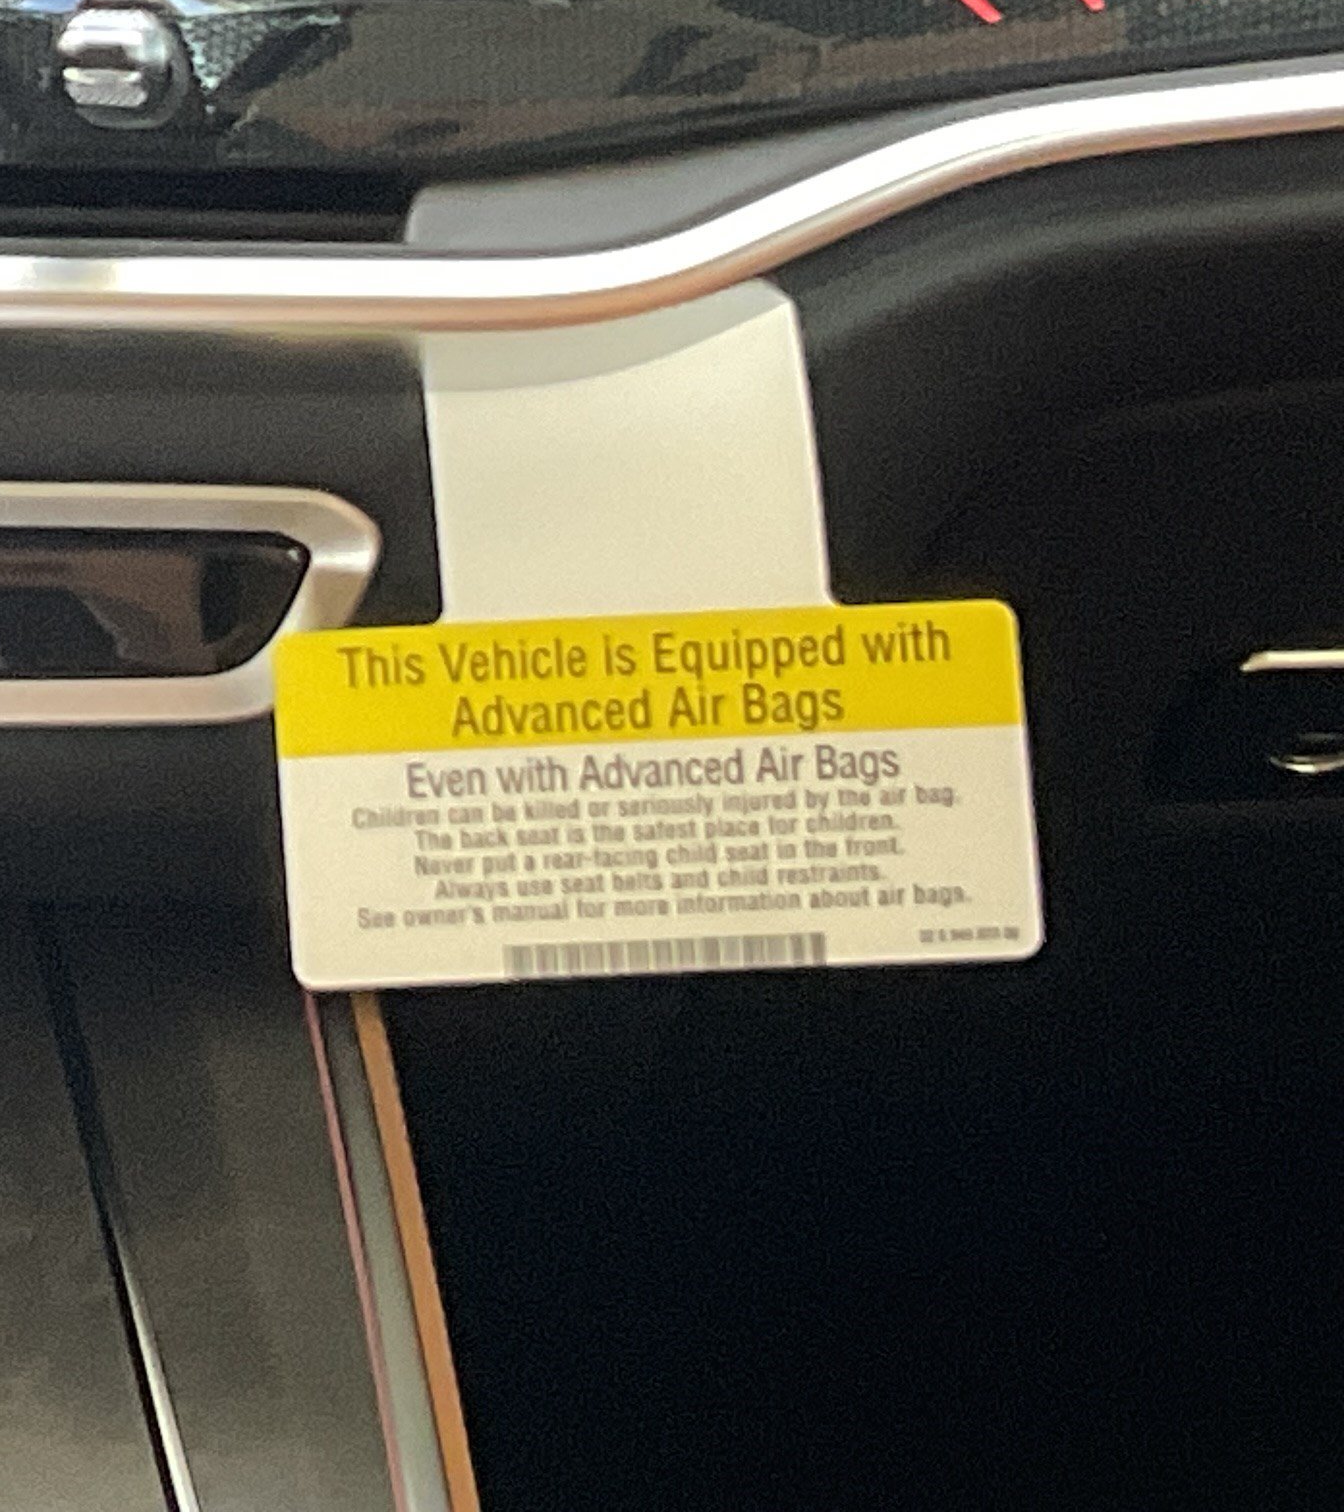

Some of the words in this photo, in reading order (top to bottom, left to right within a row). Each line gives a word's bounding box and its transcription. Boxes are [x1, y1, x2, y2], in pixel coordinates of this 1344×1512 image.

[337, 643, 426, 688] This
[439, 638, 588, 683] Vehicle
[604, 634, 637, 676] is
[653, 624, 846, 679] Equipped
[862, 620, 952, 664] with
[451, 689, 651, 738] Advanced
[669, 684, 726, 728] Air
[743, 683, 845, 731] Bags
[407, 761, 487, 799] Even
[496, 756, 569, 794] with
[579, 747, 745, 791] Advanced
[757, 747, 804, 784] Air
[815, 744, 901, 786] Bags
